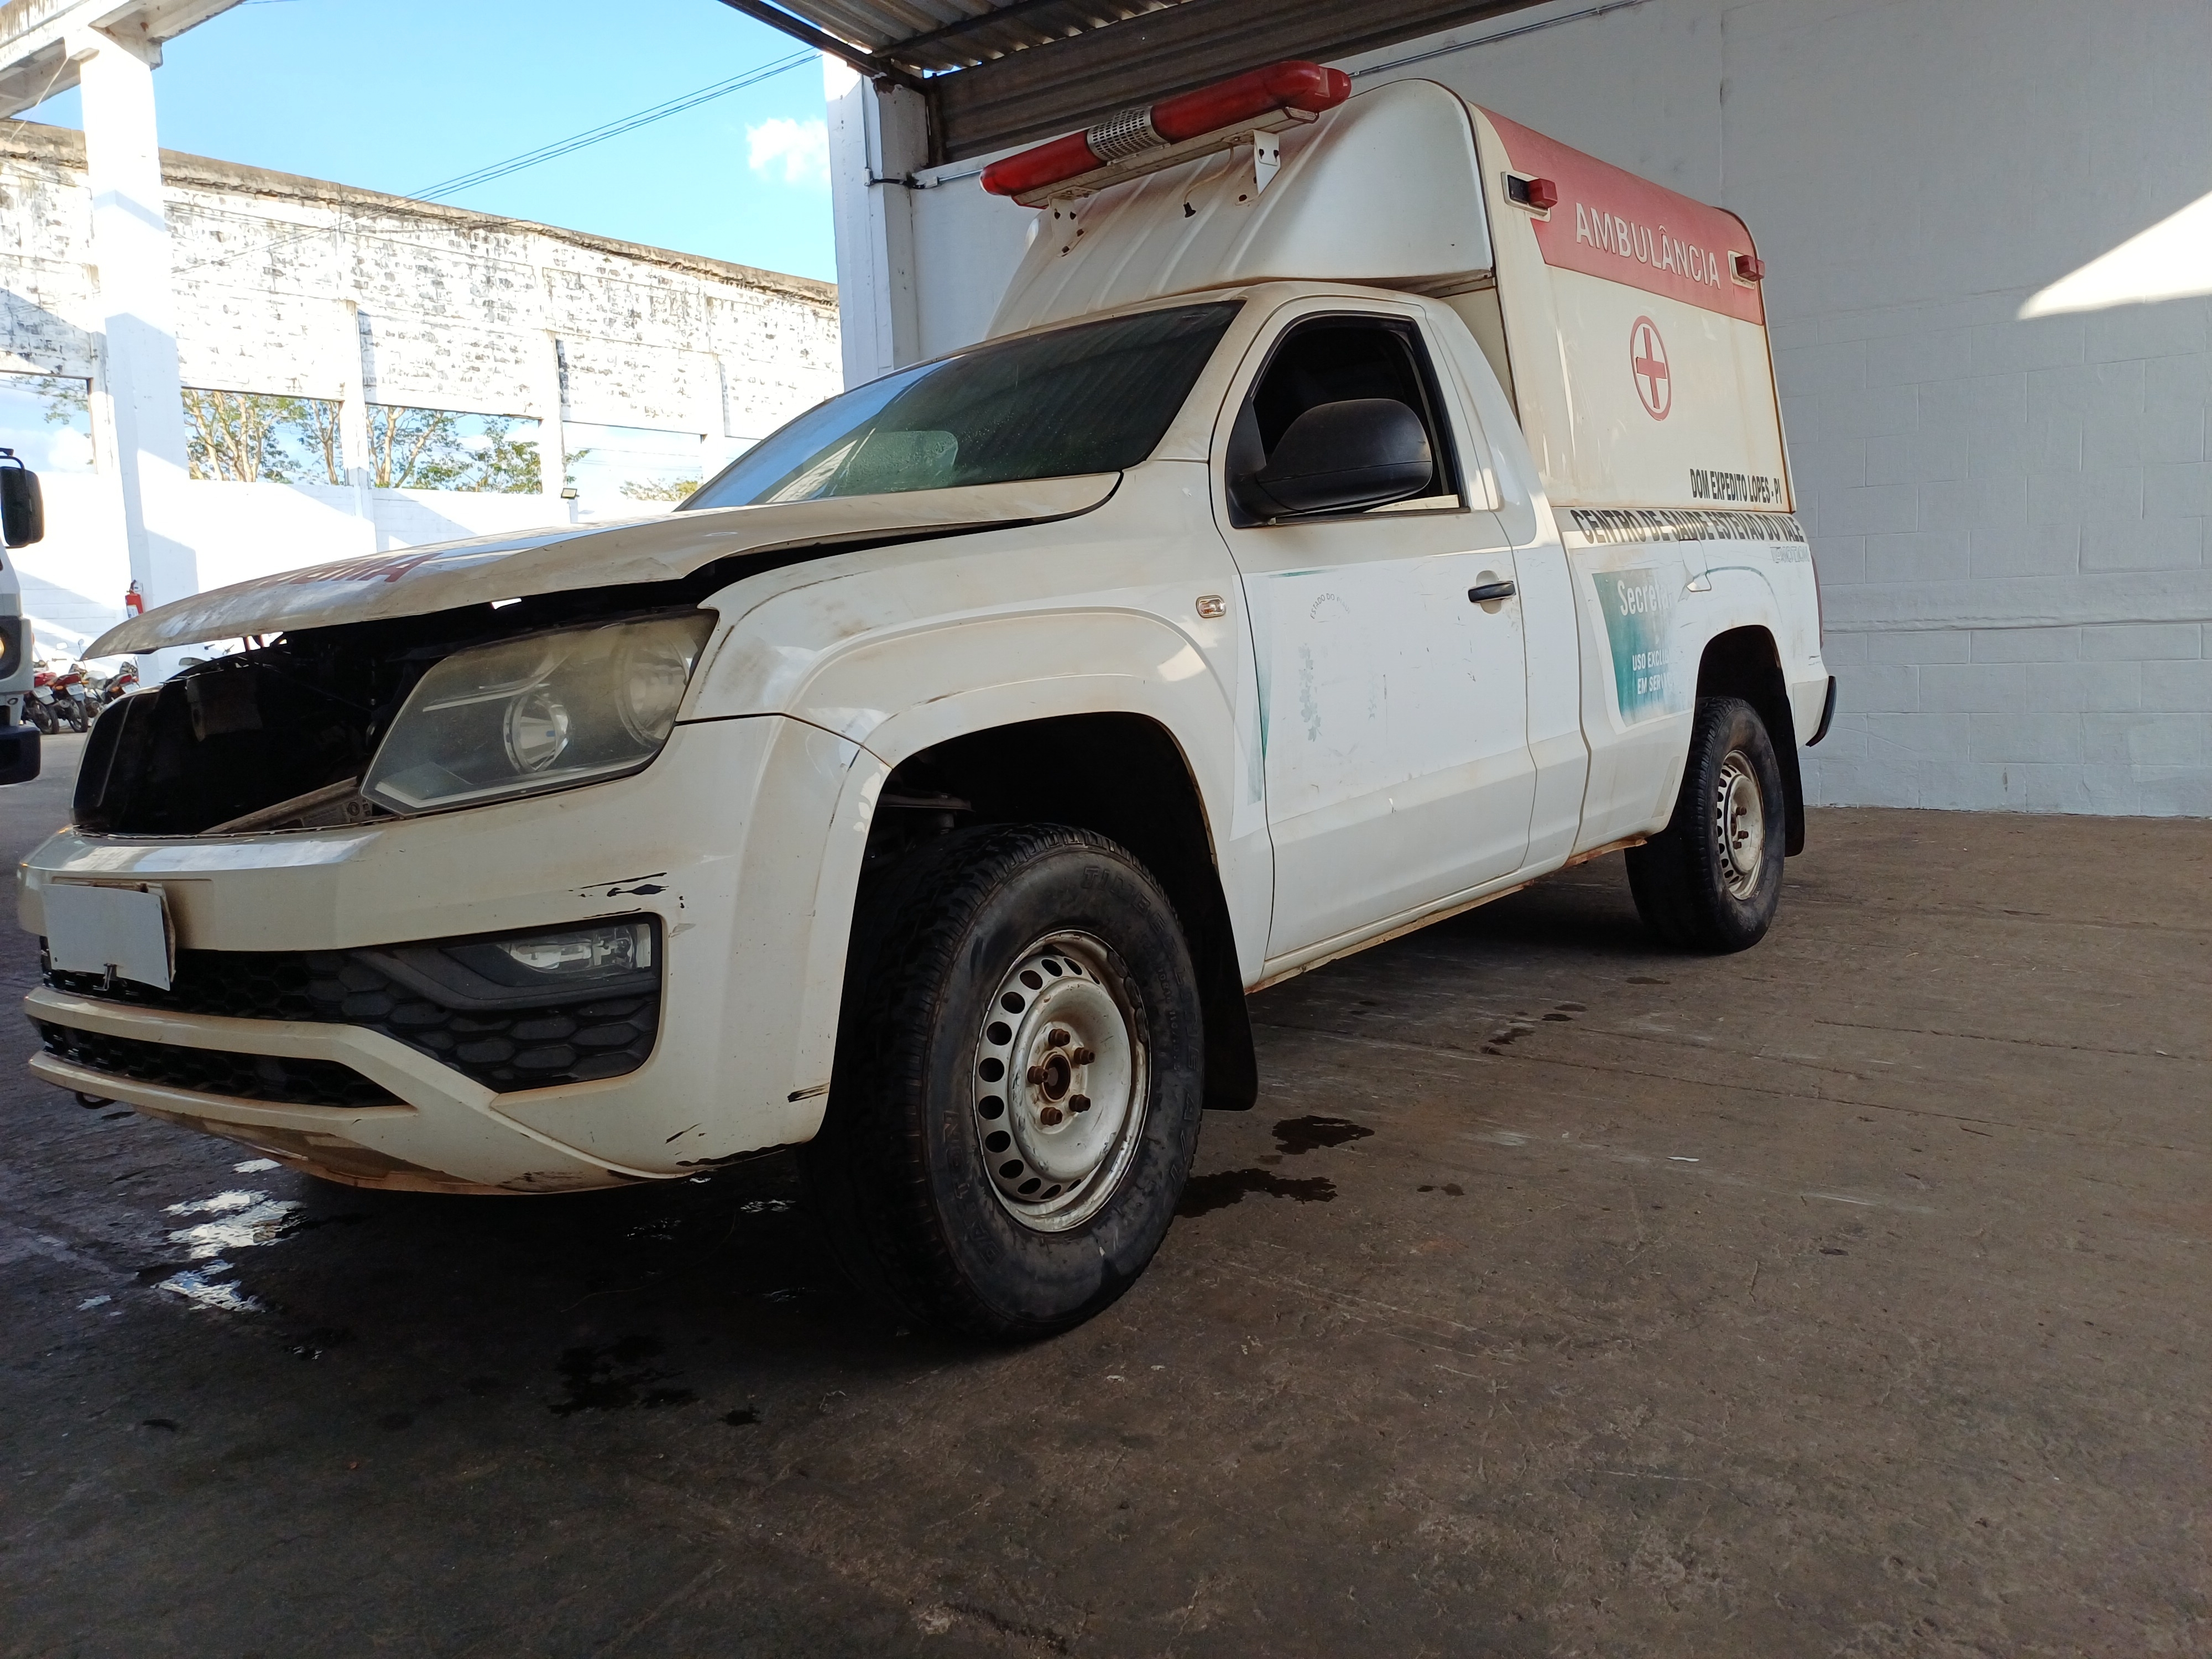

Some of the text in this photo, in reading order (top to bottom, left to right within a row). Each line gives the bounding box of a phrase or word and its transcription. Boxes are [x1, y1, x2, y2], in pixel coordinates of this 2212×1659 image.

[1576, 202, 1720, 290] AMBULÂNCIA
[1690, 468, 1710, 499] DOM
[1710, 471, 1747, 502] EXPEDITO
[1747, 475, 1771, 503] LOPES
[1773, 478, 1782, 504] PI
[1570, 510, 1646, 544] CENTRO
[1636, 510, 1671, 541] DE
[1754, 514, 1780, 541] DO
[1770, 515, 1804, 542] VALE
[1632, 654, 1646, 671] USO
[1637, 677, 1647, 695] EM
